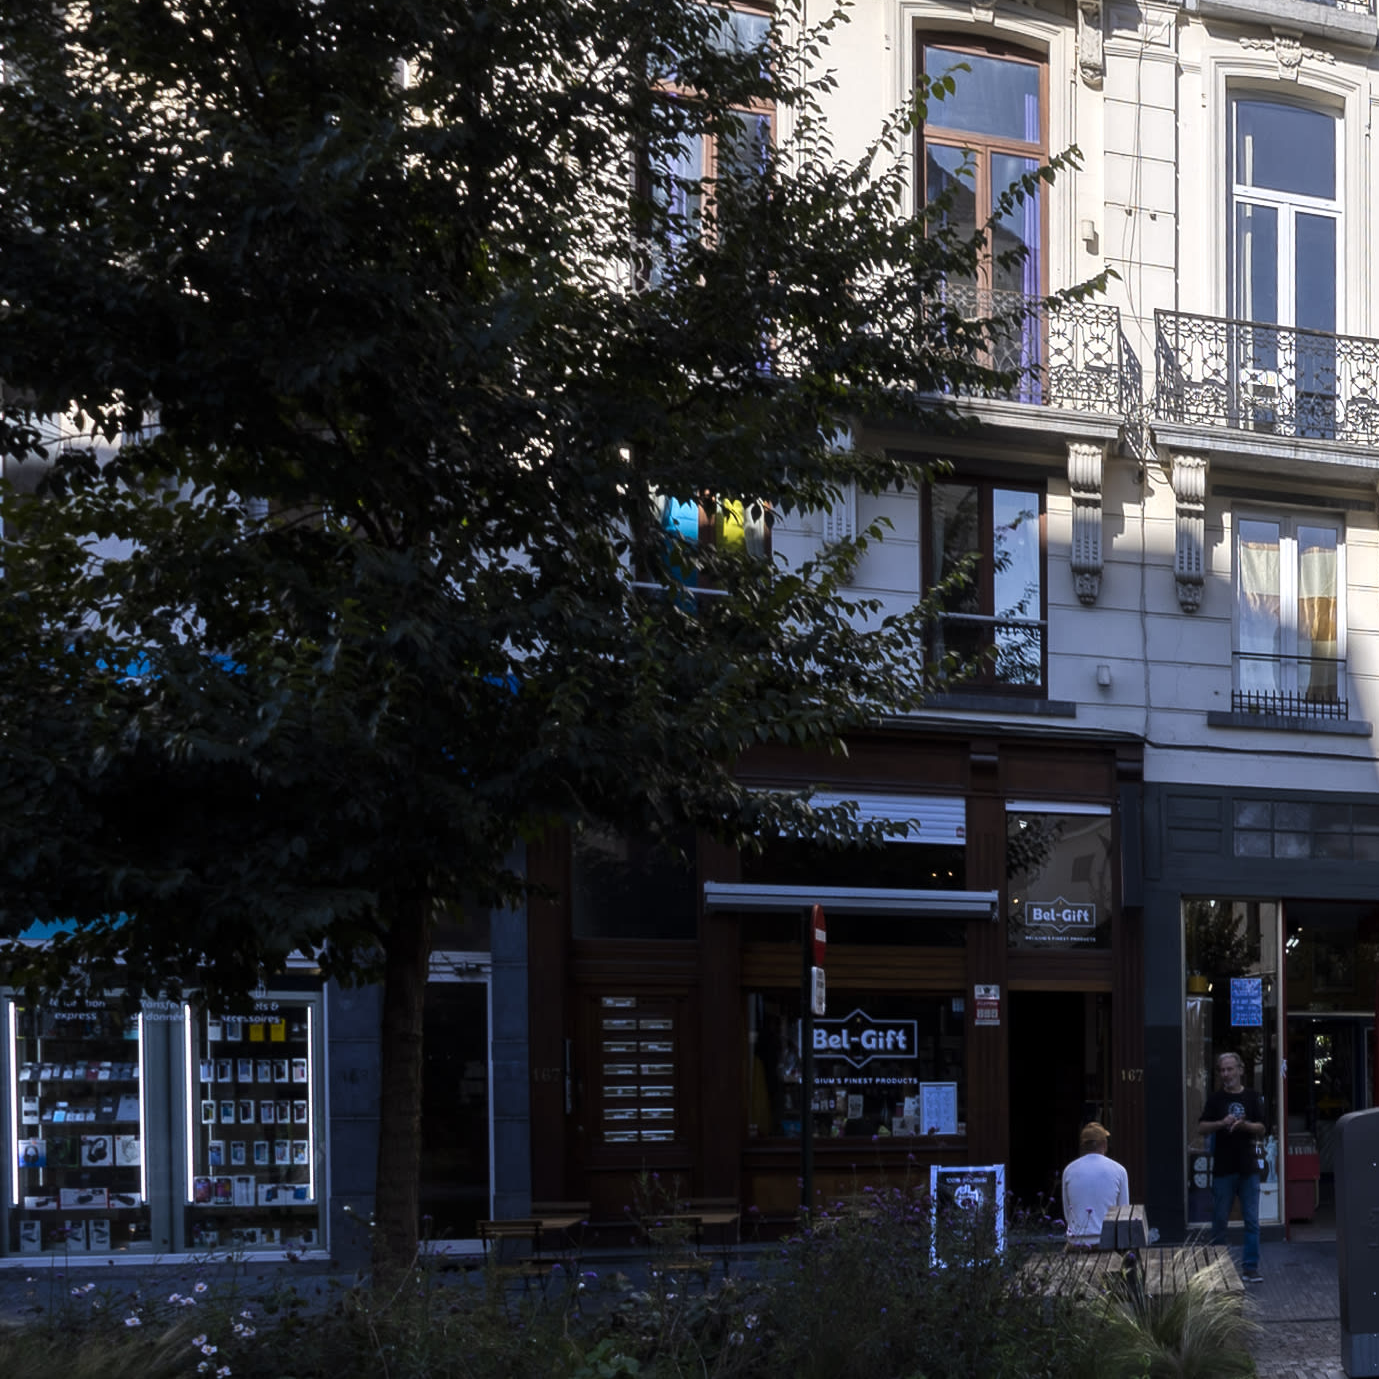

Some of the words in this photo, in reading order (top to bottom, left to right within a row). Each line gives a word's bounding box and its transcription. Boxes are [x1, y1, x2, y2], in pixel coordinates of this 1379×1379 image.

[1032, 907, 1089, 922] Bel-Gift
[54, 1011, 97, 1022] express
[813, 1028, 908, 1051] Bel-Gift
[844, 1077, 873, 1085] FINEST
[875, 1077, 919, 1085] PRODUCTS
[1120, 1068, 1144, 1082] 167
